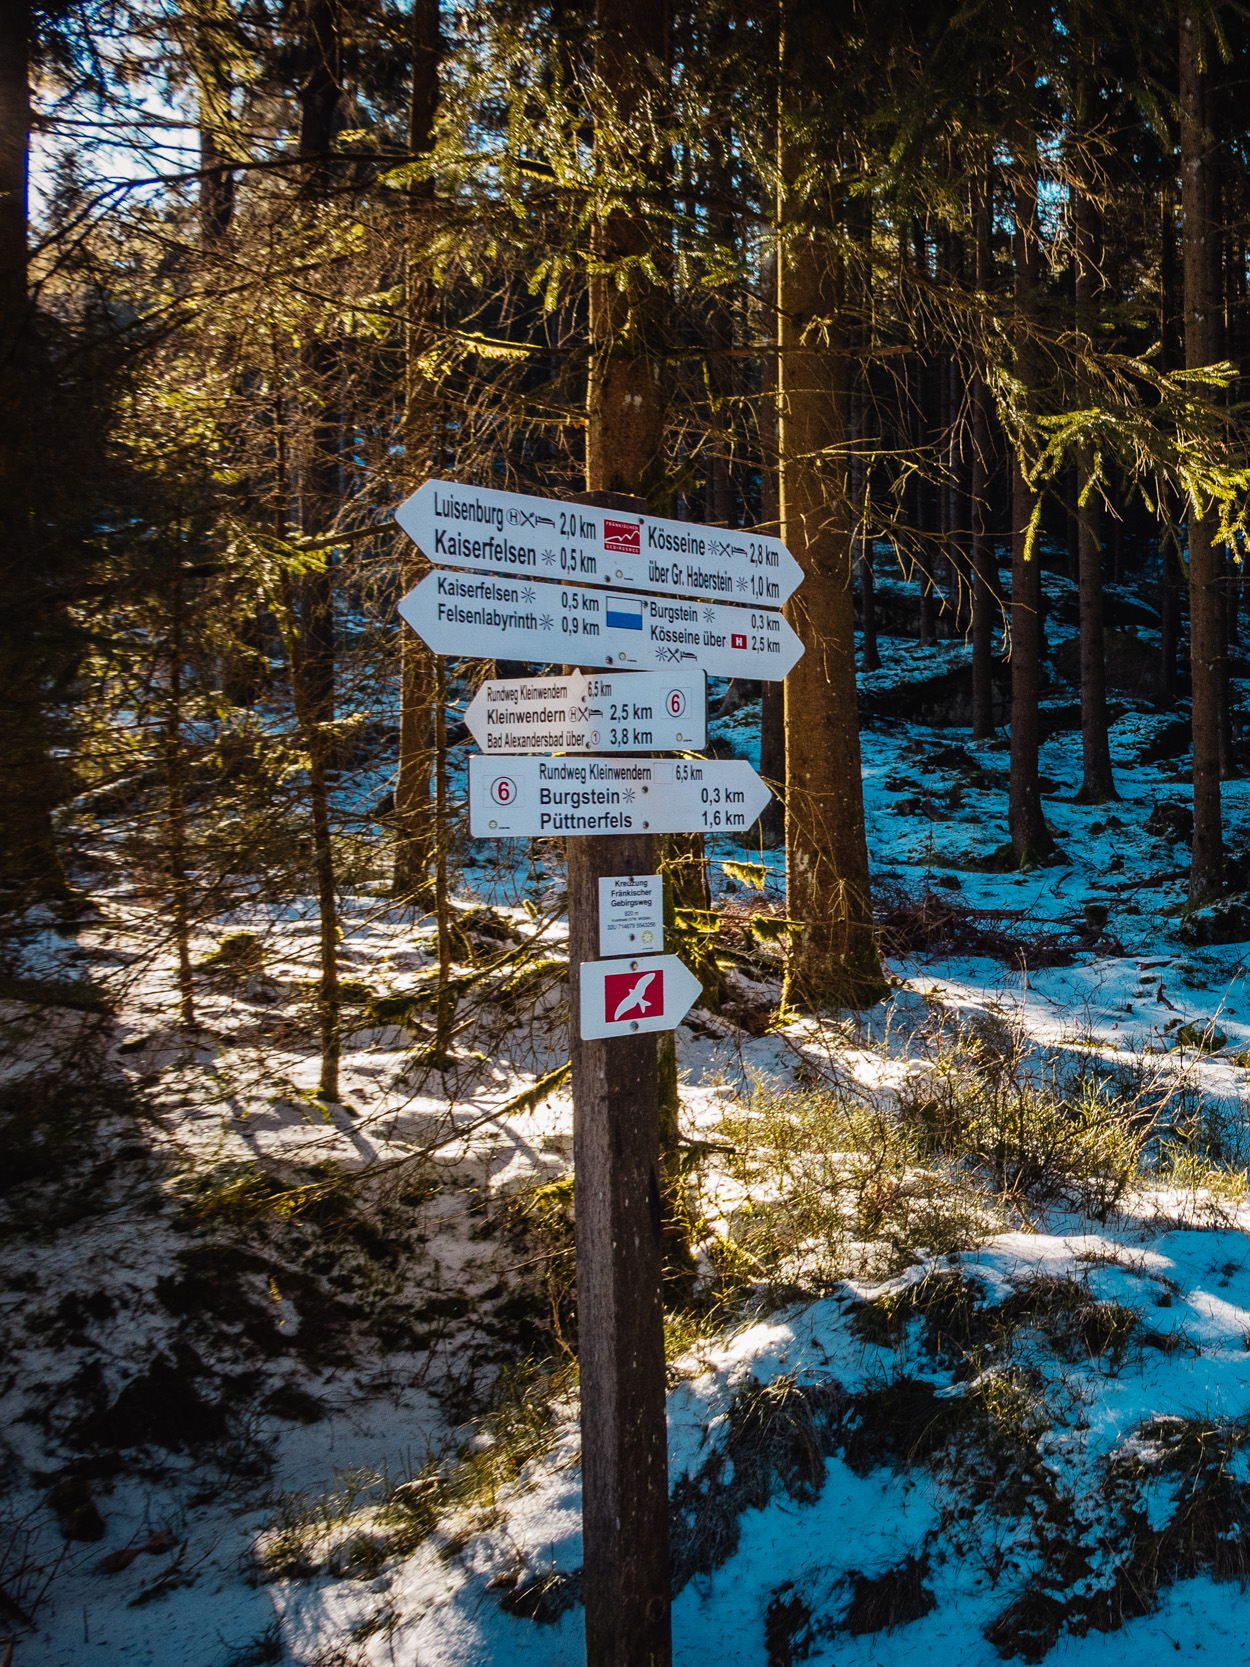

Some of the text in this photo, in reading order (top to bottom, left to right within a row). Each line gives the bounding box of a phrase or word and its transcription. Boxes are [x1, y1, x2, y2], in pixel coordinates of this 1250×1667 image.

[434, 492, 503, 532] Luisenburg
[560, 512, 576, 540] 2,0
[580, 516, 596, 540] km
[435, 529, 596, 574] Kaiserfelsen 0,5 km
[648, 526, 779, 568] Kösseine 2,8 km
[649, 560, 779, 599] über Gr. Haberstein 1,0 km
[438, 577, 599, 612] Kaiserfelsen 0,5 km
[438, 603, 599, 636] Felsenlabyrinth 0,9 km
[650, 602, 780, 631] Burgstein 0,3 km
[651, 625, 700, 645] Kösseine
[704, 631, 726, 647] über
[752, 636, 764, 652] 2,5
[767, 638, 780, 653] km
[487, 681, 611, 704] Rundweg Kleinwendern 6,5 km
[671, 694, 680, 713] 6
[487, 707, 565, 724] Kleinwendern
[610, 704, 628, 723] 2,5
[633, 703, 652, 719] km
[487, 733, 502, 748] Bad
[504, 731, 563, 748] Alexandersbad
[566, 731, 585, 746] über
[610, 728, 628, 747] 3,8
[633, 728, 652, 744] km
[540, 763, 703, 783] Rundweg Kleinwendern 6,5 km
[498, 781, 509, 801] 6
[540, 788, 744, 808] Burgstein 0,3 km
[540, 810, 744, 829] Püttnerfels 1,6 km
[611, 889, 652, 897] Fränkischer
